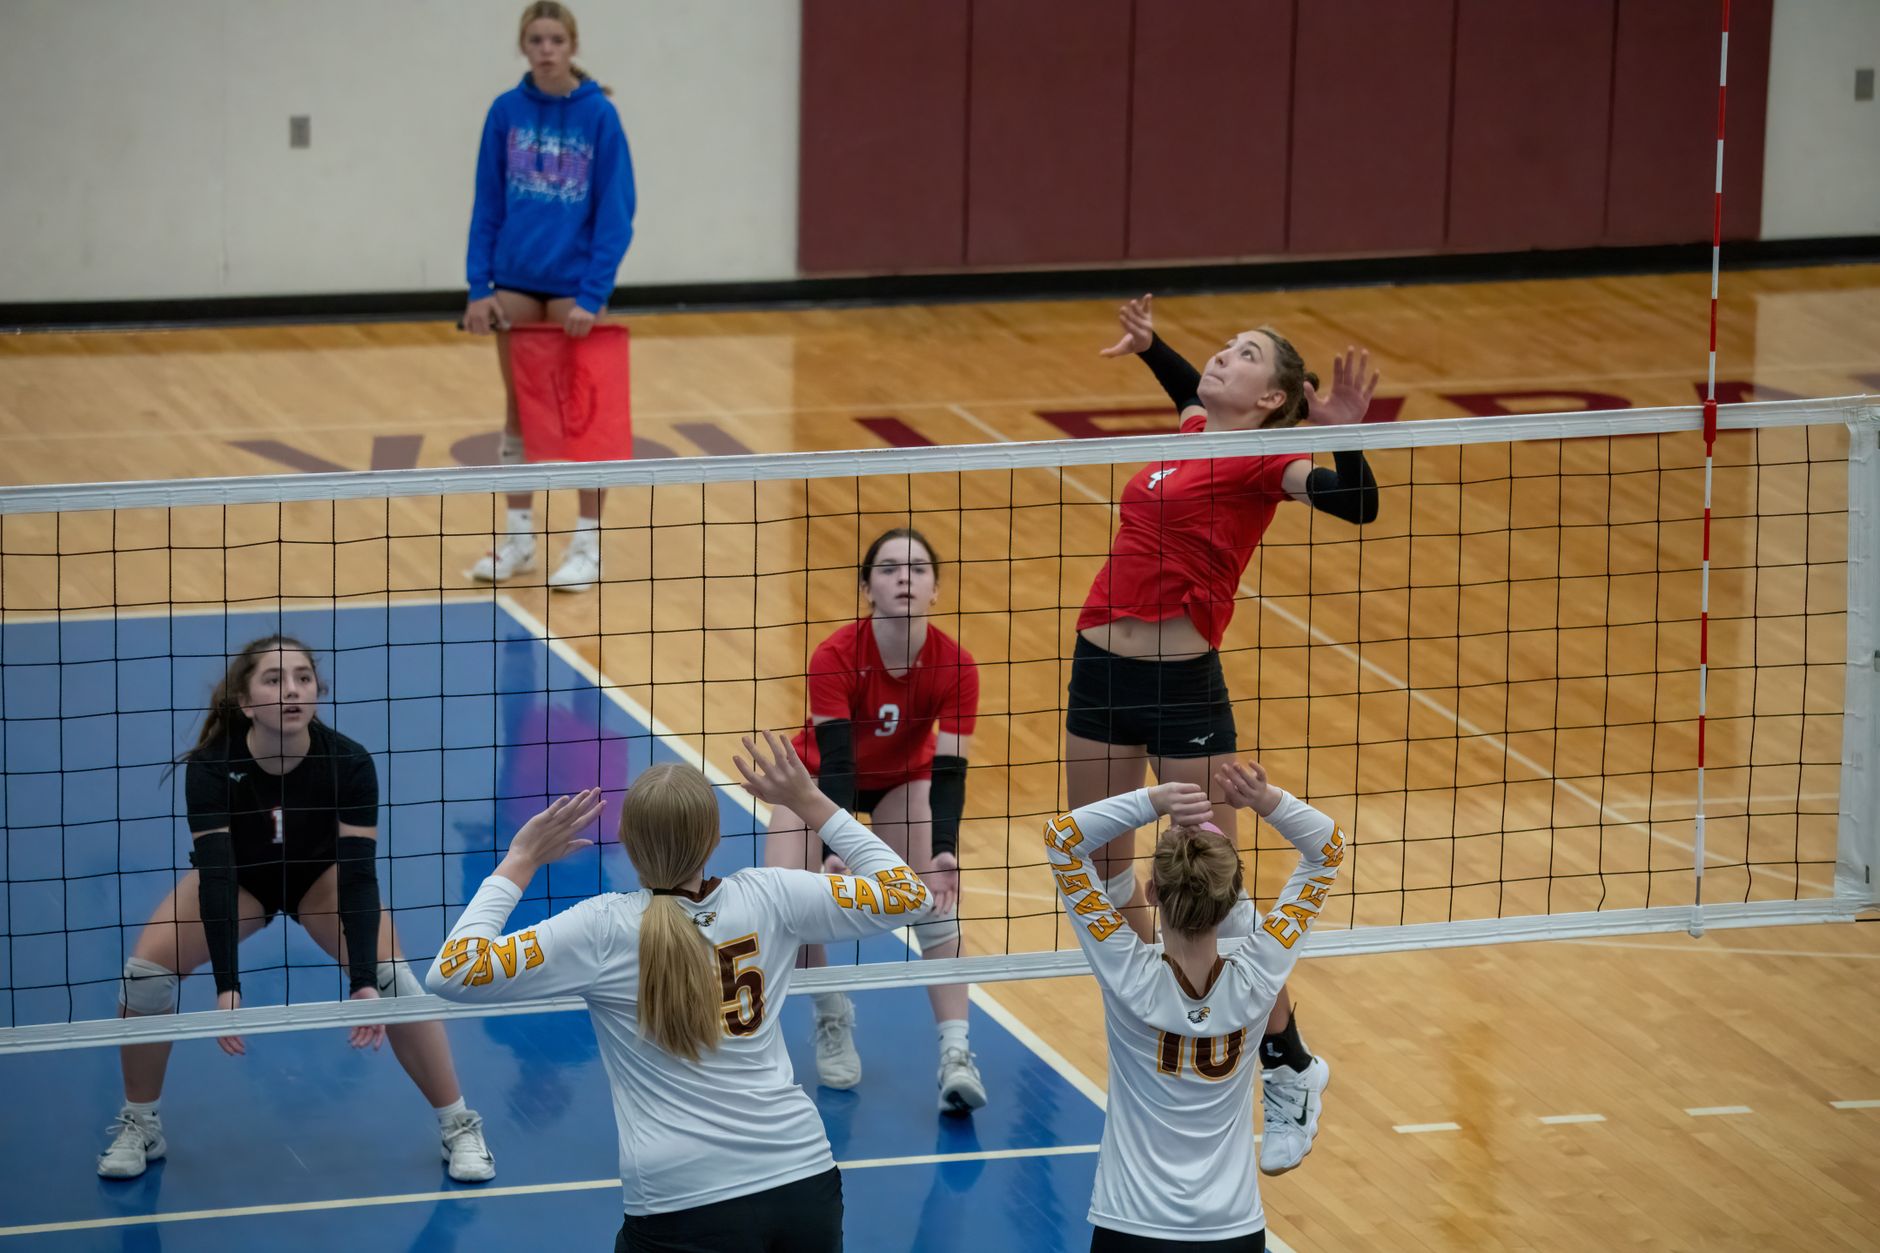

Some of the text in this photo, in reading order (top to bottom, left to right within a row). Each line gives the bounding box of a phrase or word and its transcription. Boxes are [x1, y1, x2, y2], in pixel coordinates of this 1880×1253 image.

[874, 703, 900, 737] 3
[271, 806, 284, 844] 1
[714, 931, 765, 1037] 5
[1157, 1027, 1247, 1082] 10
